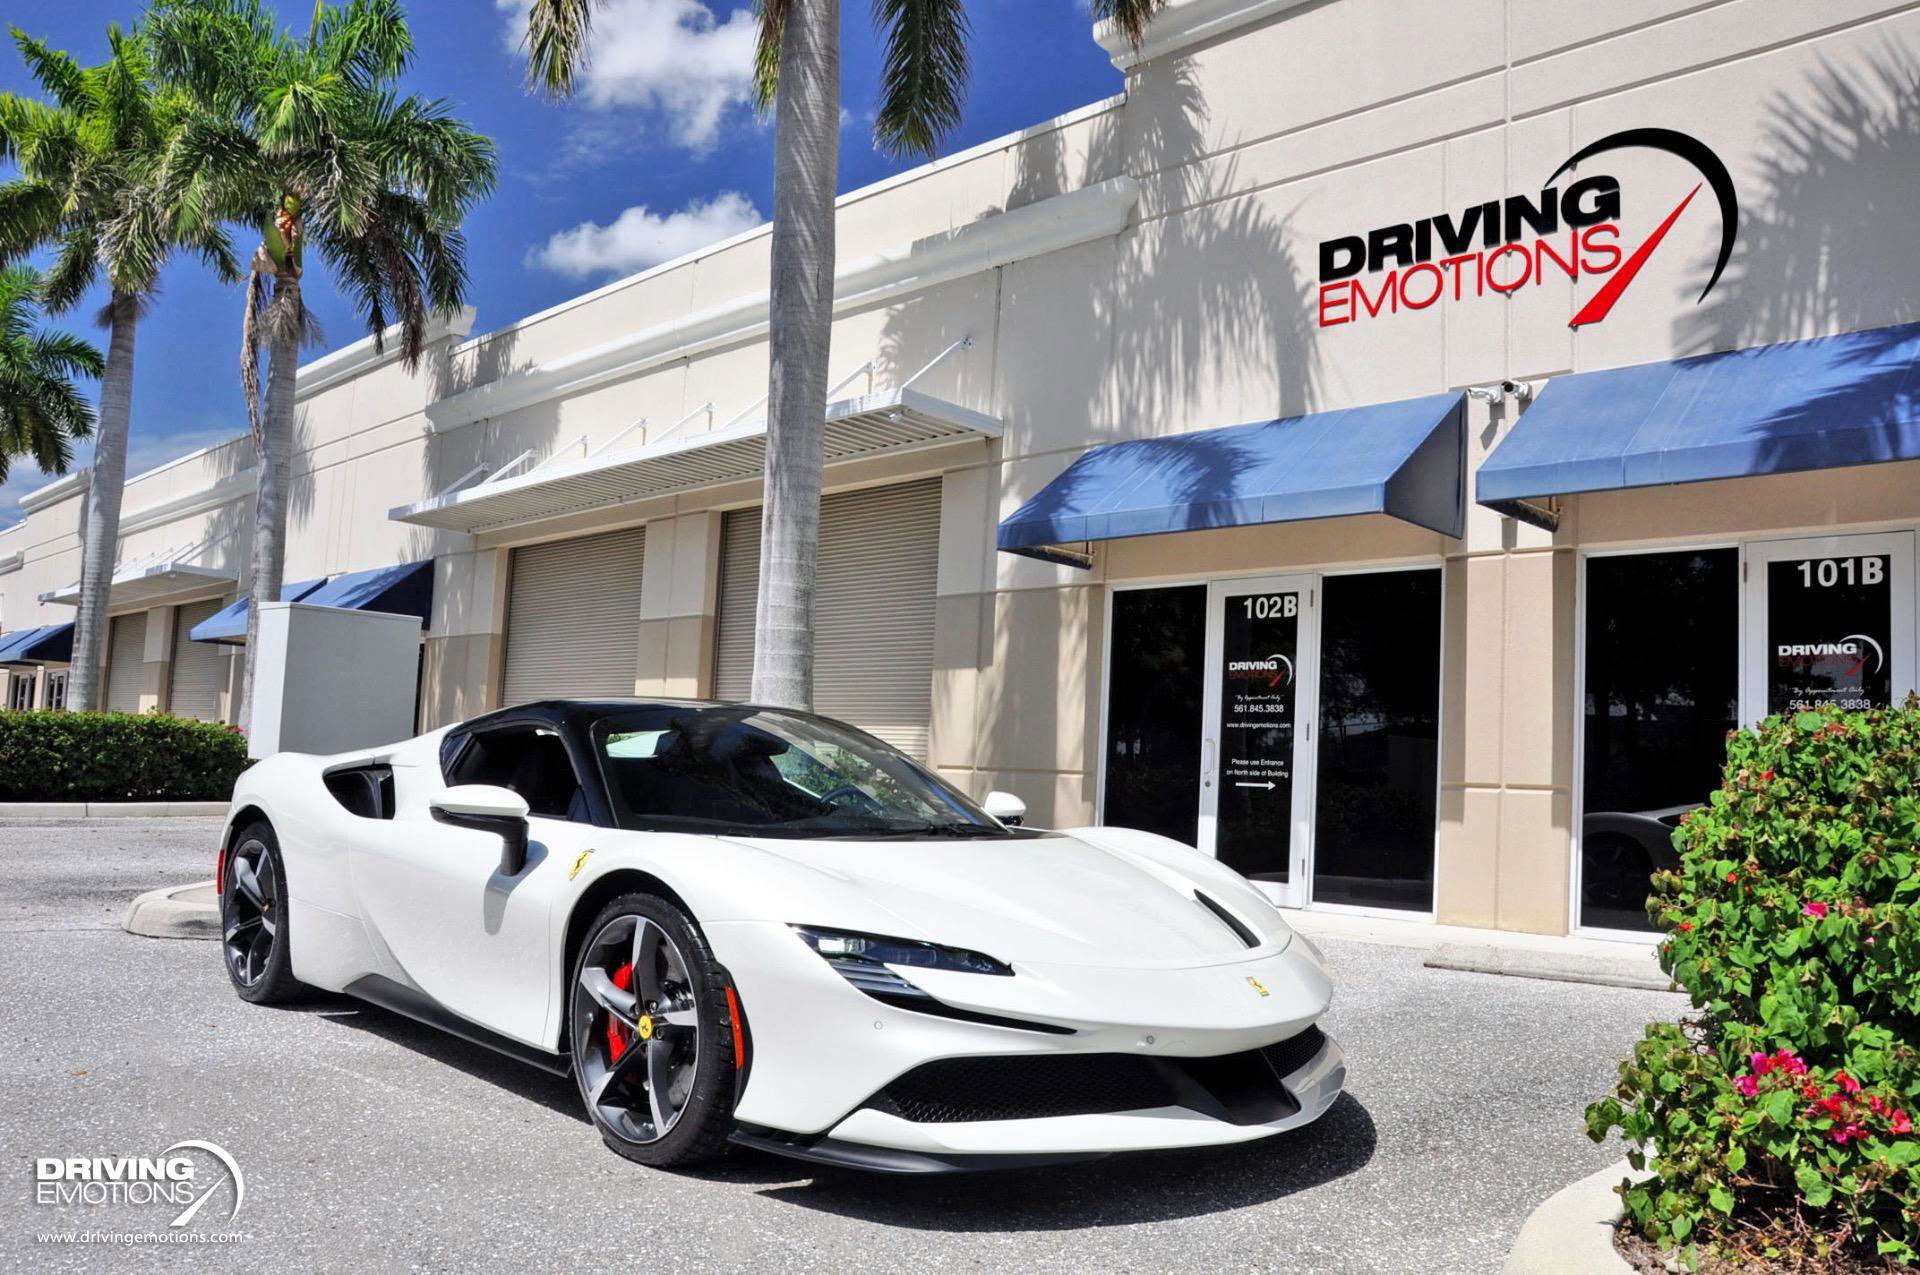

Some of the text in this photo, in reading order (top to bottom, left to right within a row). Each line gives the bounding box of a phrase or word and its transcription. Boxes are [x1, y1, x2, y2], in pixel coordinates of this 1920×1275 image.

[1319, 175, 1621, 283] DRIVING
[1319, 224, 1622, 327] EMOTIONS
[1798, 557, 1884, 588] 101B
[1243, 595, 1298, 619] 102B
[1778, 643, 1857, 655] DRIVING
[1229, 661, 1278, 671] DRIVING
[1234, 704, 1284, 713] 561.845.3838
[1231, 758, 1249, 766] Please
[1260, 759, 1284, 767] Entrance
[1249, 769, 1260, 777] side
[1267, 769, 1289, 778] Building
